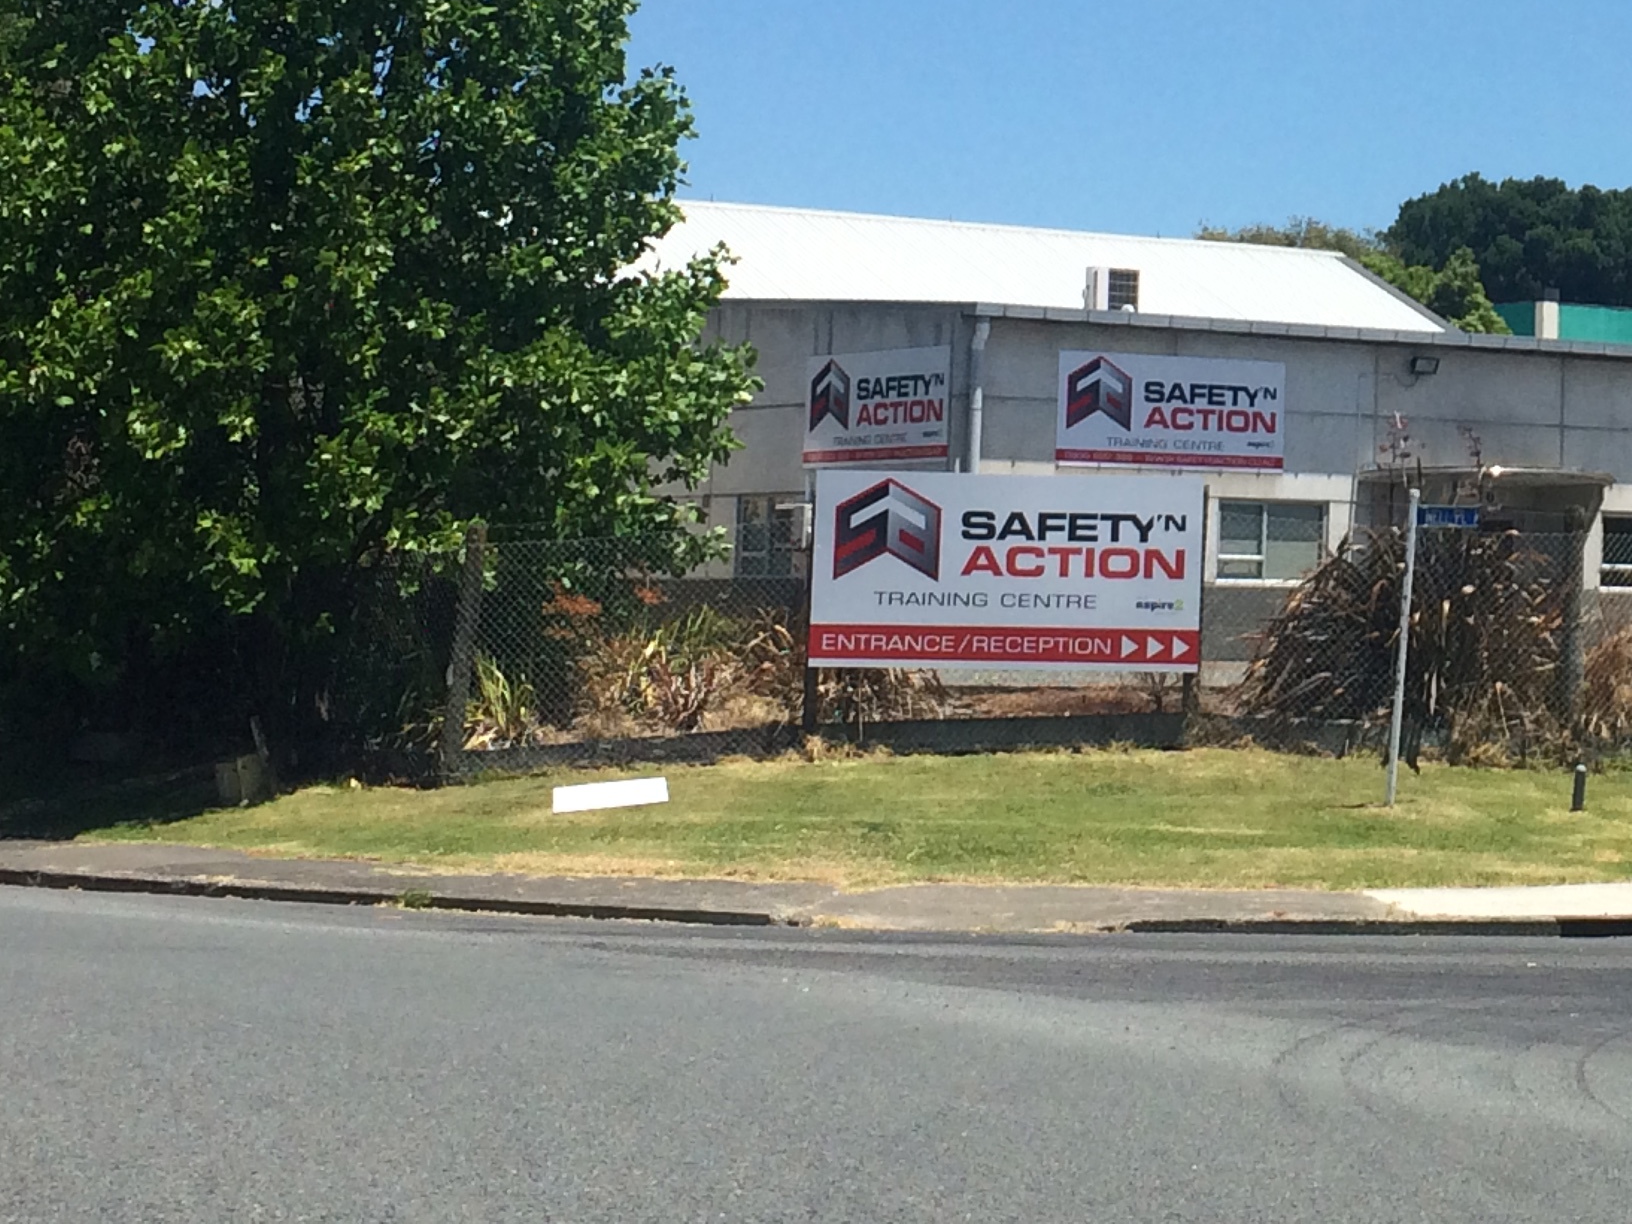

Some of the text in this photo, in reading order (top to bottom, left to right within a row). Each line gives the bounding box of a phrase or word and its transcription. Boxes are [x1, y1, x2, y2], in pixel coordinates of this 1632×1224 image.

[857, 372, 944, 400] SAFETY'N
[1143, 381, 1277, 407] SAFETY'N
[856, 398, 943, 427] ACTION
[1143, 406, 1276, 433] ACTION
[1106, 436, 1225, 452] TRAINING CENTRE
[961, 510, 1187, 543] SAFETY'N
[960, 545, 1186, 580] ACTION
[874, 590, 1098, 610] TRAINING CENTRE
[821, 633, 1112, 656] ENTRANCE/RECEPTION
